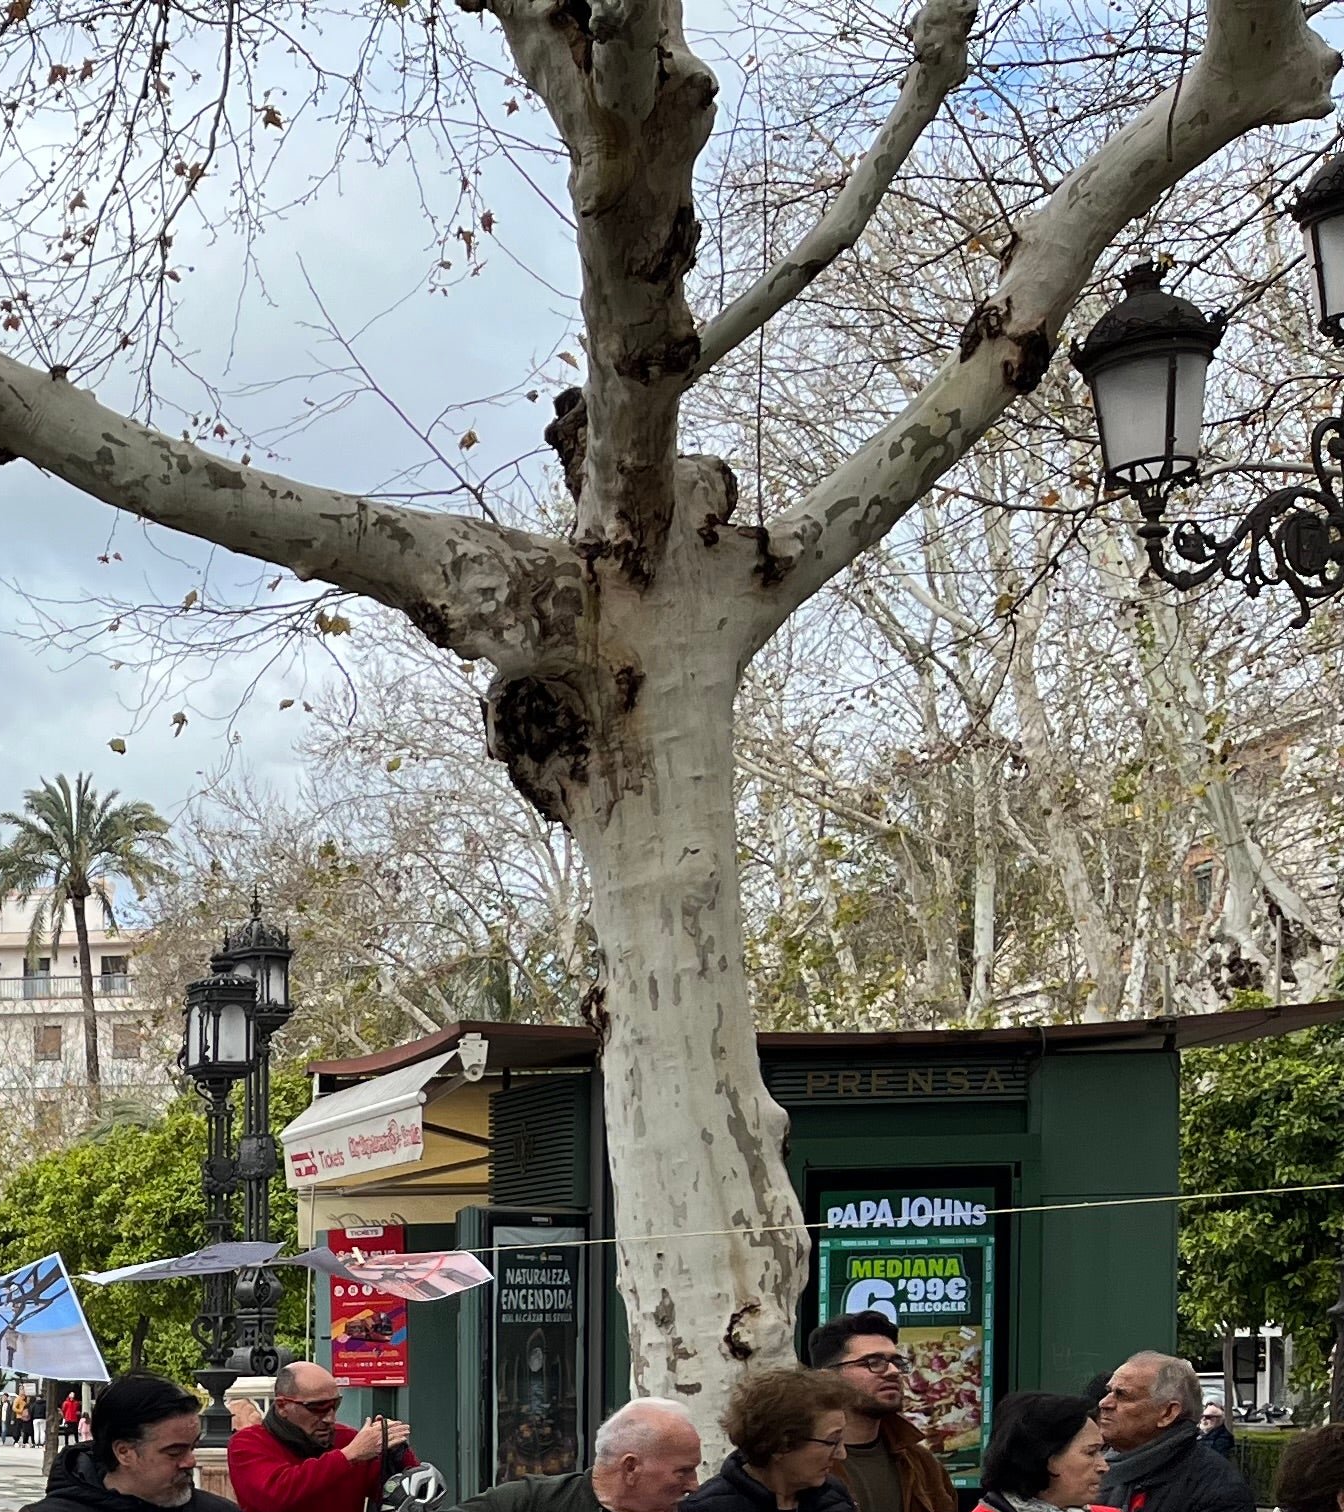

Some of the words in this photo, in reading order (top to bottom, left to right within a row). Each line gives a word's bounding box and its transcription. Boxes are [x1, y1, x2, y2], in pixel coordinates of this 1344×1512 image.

[806, 1067, 1005, 1096] PRENSA
[318, 1150, 345, 1169] Tickets
[827, 1198, 895, 1229] PAPA
[897, 1196, 987, 1228] JOHNS
[505, 1268, 571, 1285] NATURALEZA
[851, 1258, 960, 1278] MEDIANA
[501, 1288, 573, 1310] ENCENDIDA
[899, 1303, 909, 1313] A
[911, 1301, 967, 1313] RECOGER
